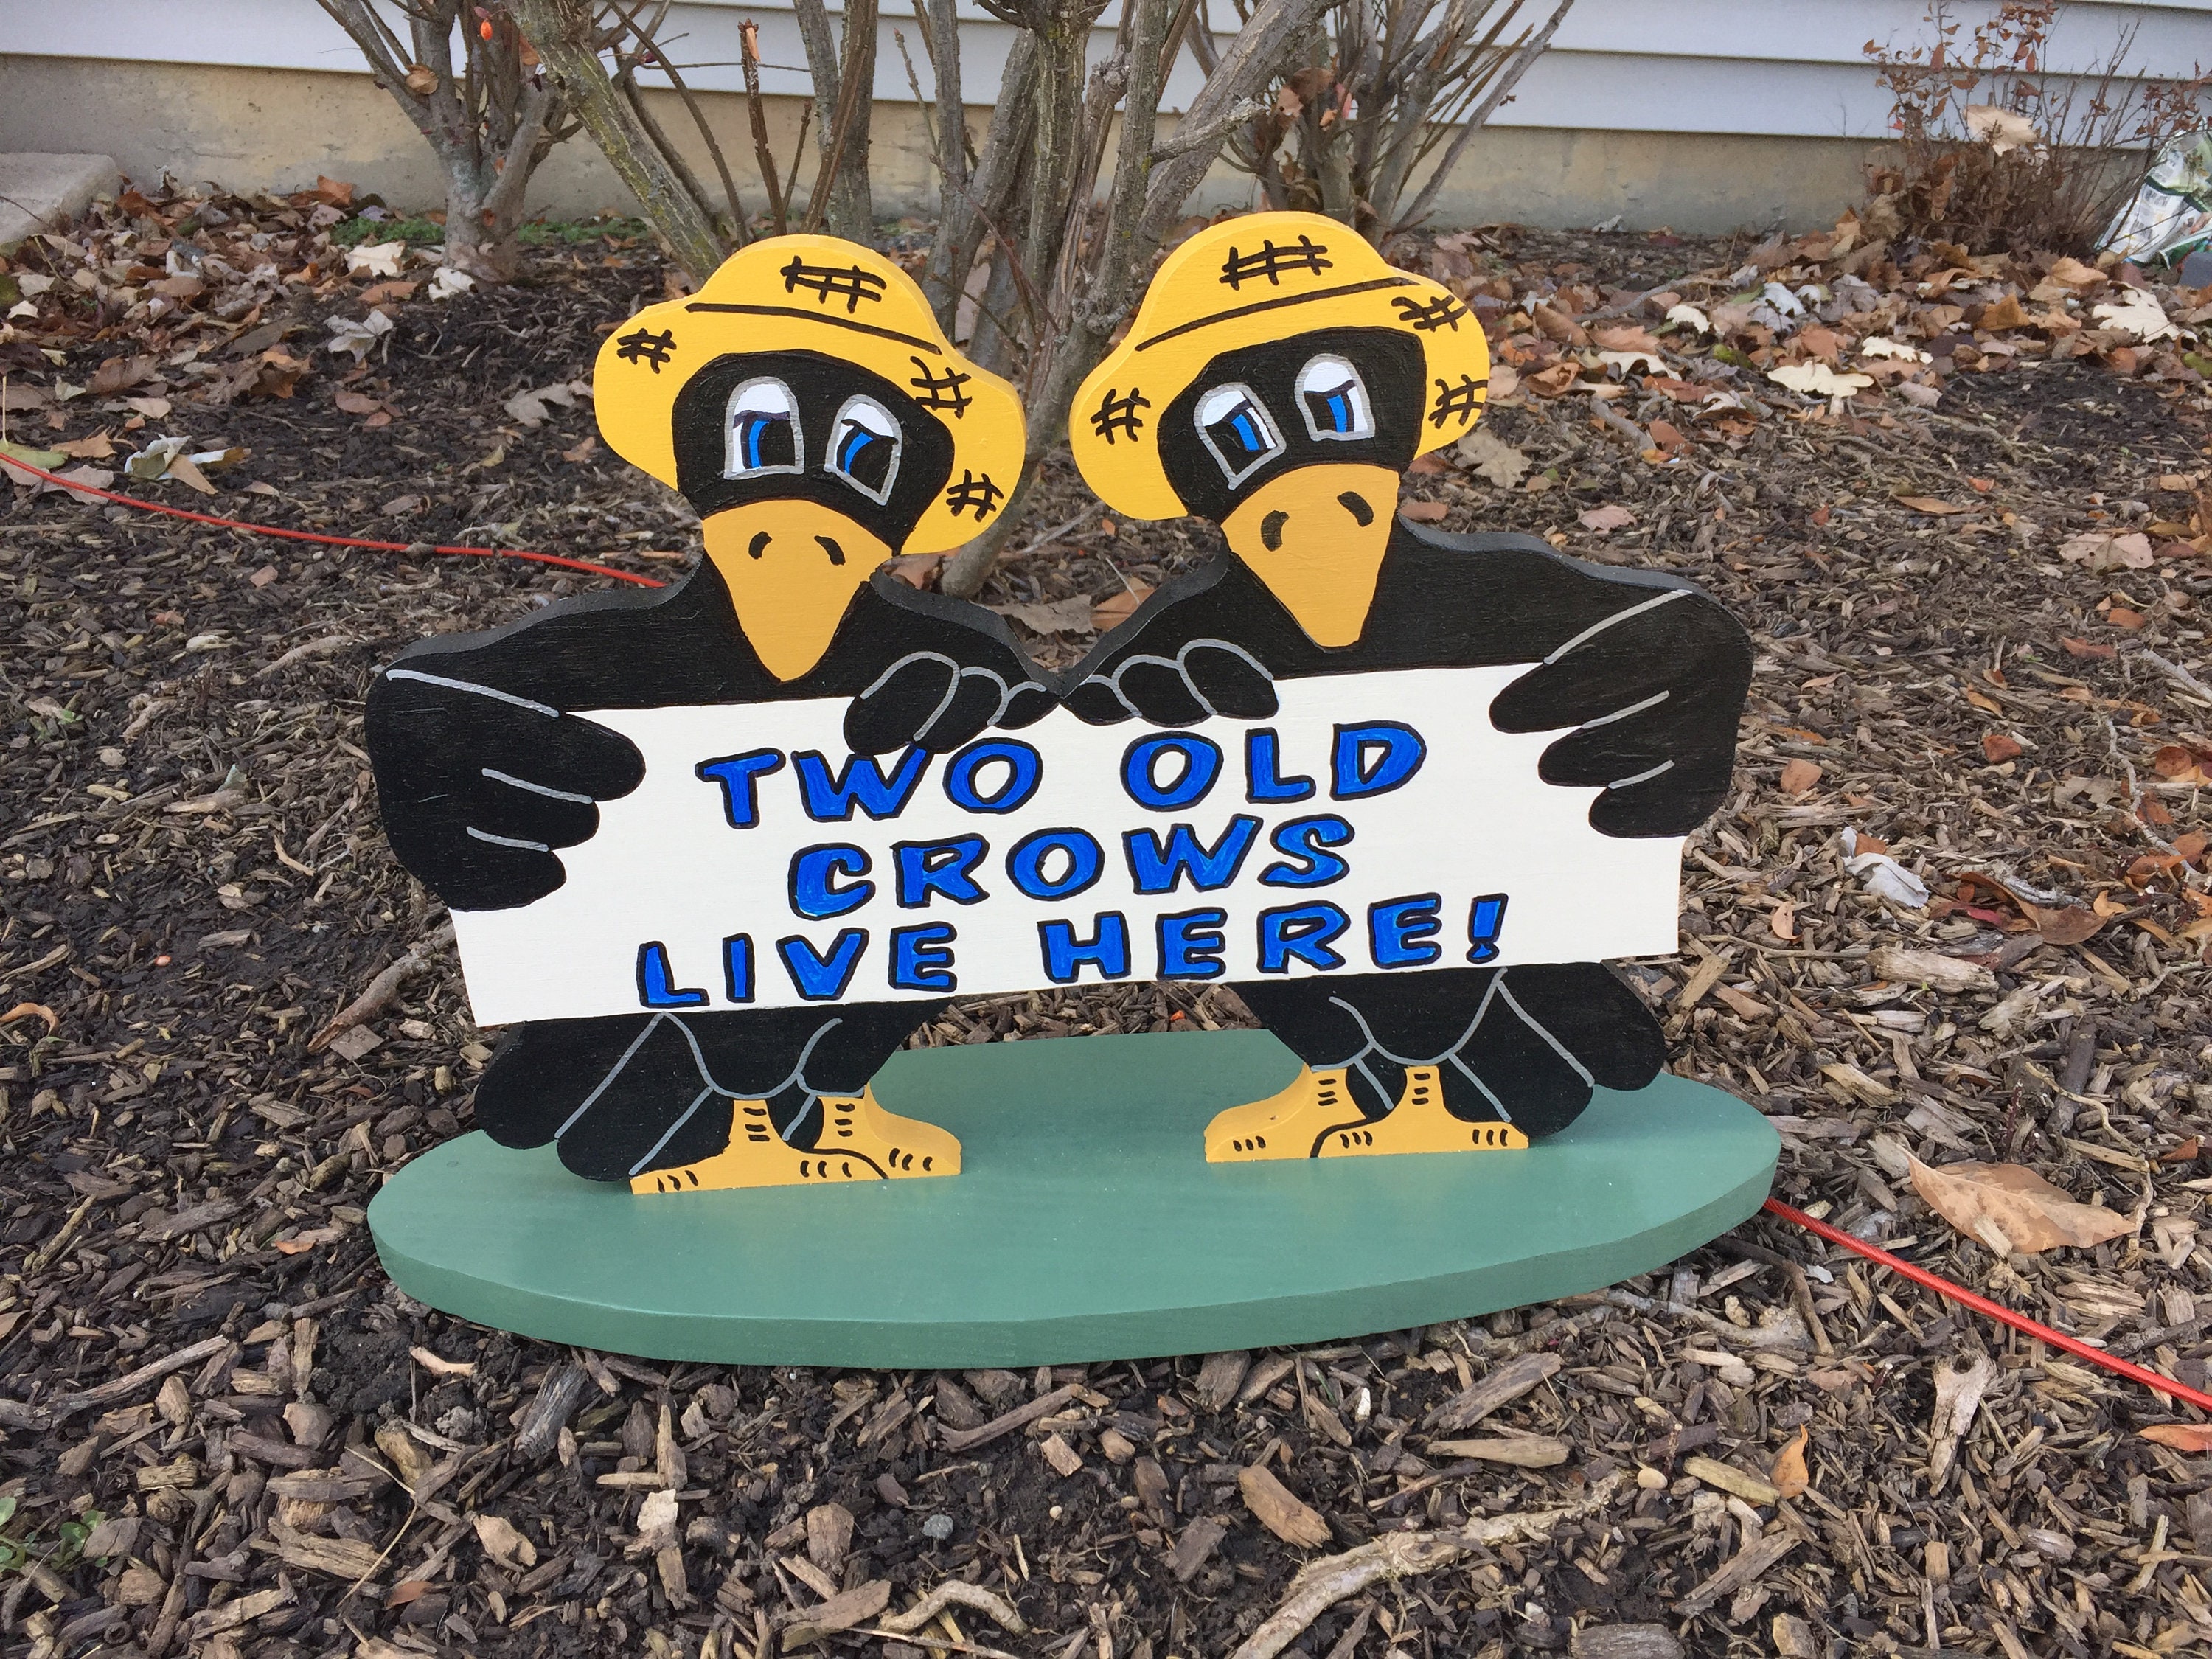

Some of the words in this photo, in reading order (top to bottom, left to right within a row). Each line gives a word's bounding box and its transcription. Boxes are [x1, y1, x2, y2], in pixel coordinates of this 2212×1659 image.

[695, 731, 1043, 829] TWO
[1121, 721, 1428, 812] OLD
[790, 814, 1357, 920] CROWS
[639, 921, 958, 1009] LIVE
[1038, 891, 1509, 985] HERE!
